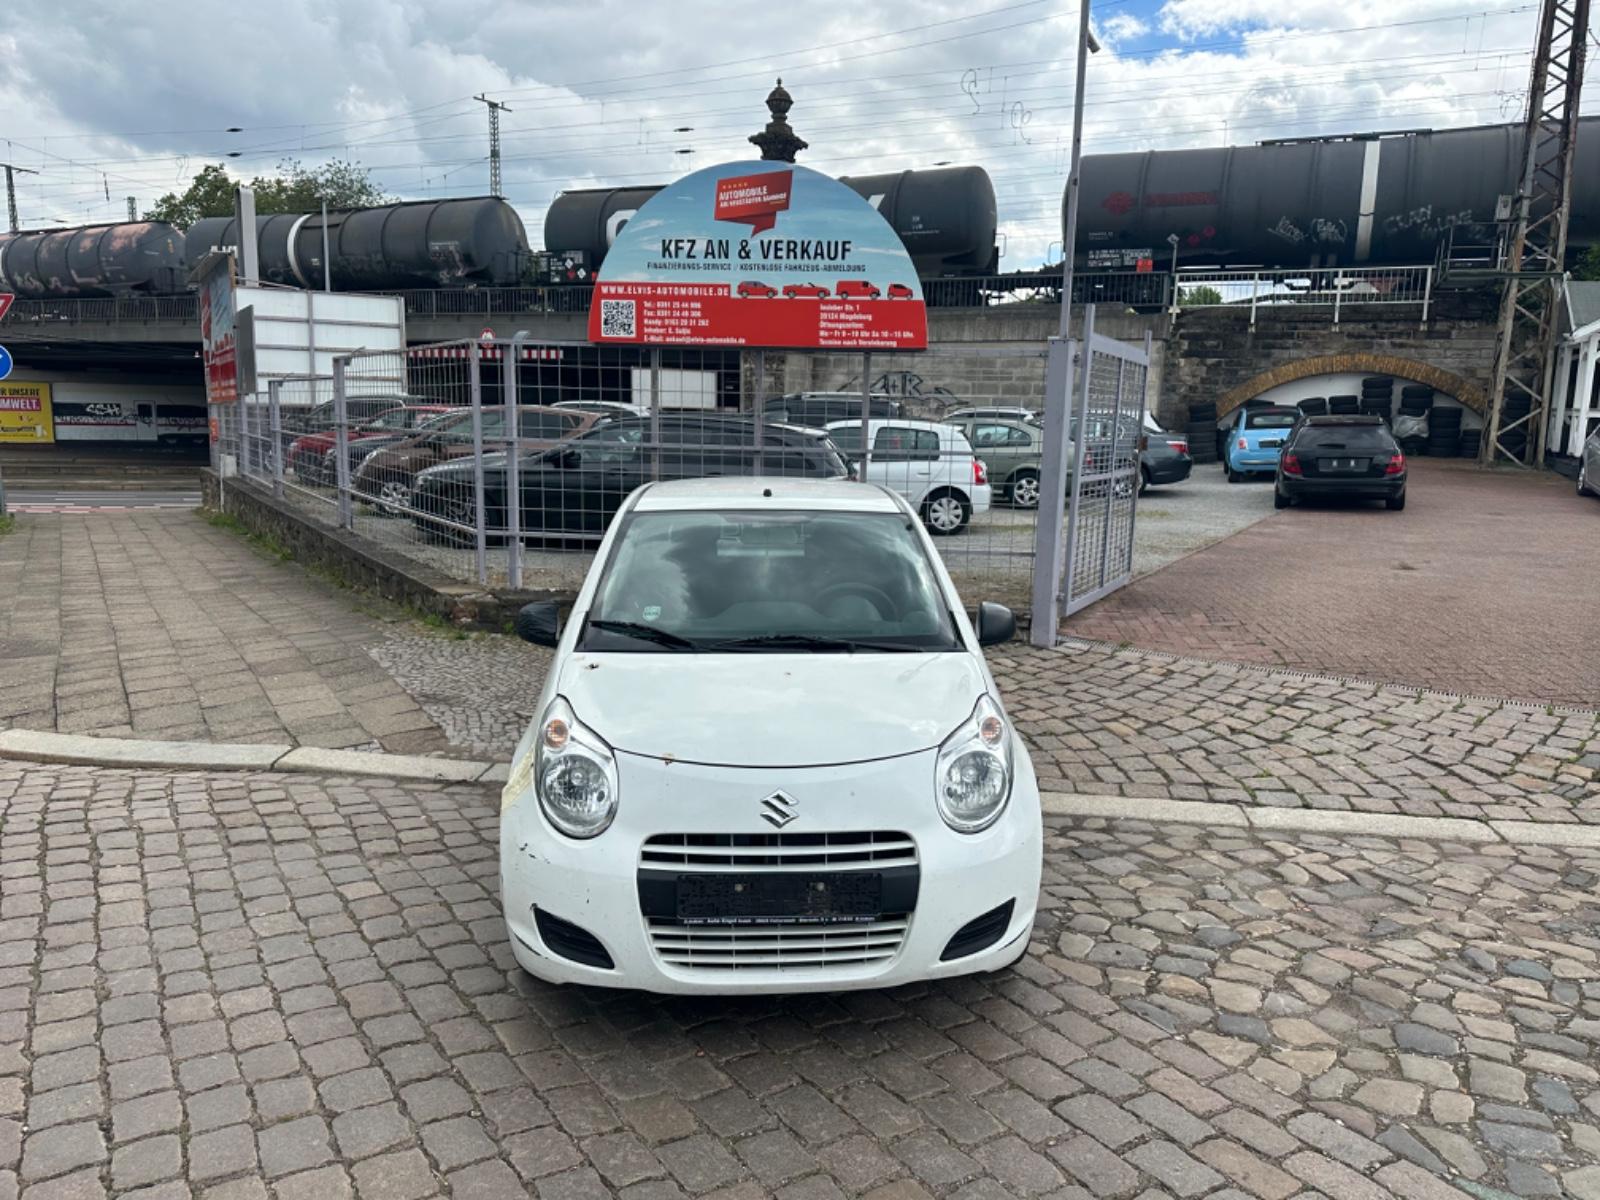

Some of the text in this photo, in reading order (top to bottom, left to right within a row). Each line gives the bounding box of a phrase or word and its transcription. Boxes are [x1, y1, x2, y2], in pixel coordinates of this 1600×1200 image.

[719, 185, 768, 200] AUTOMOBILE
[661, 239, 852, 261] KFZ AN & VERKAUF
[601, 285, 729, 296] WWW.ELVIS-AUTOMOBILE.DE
